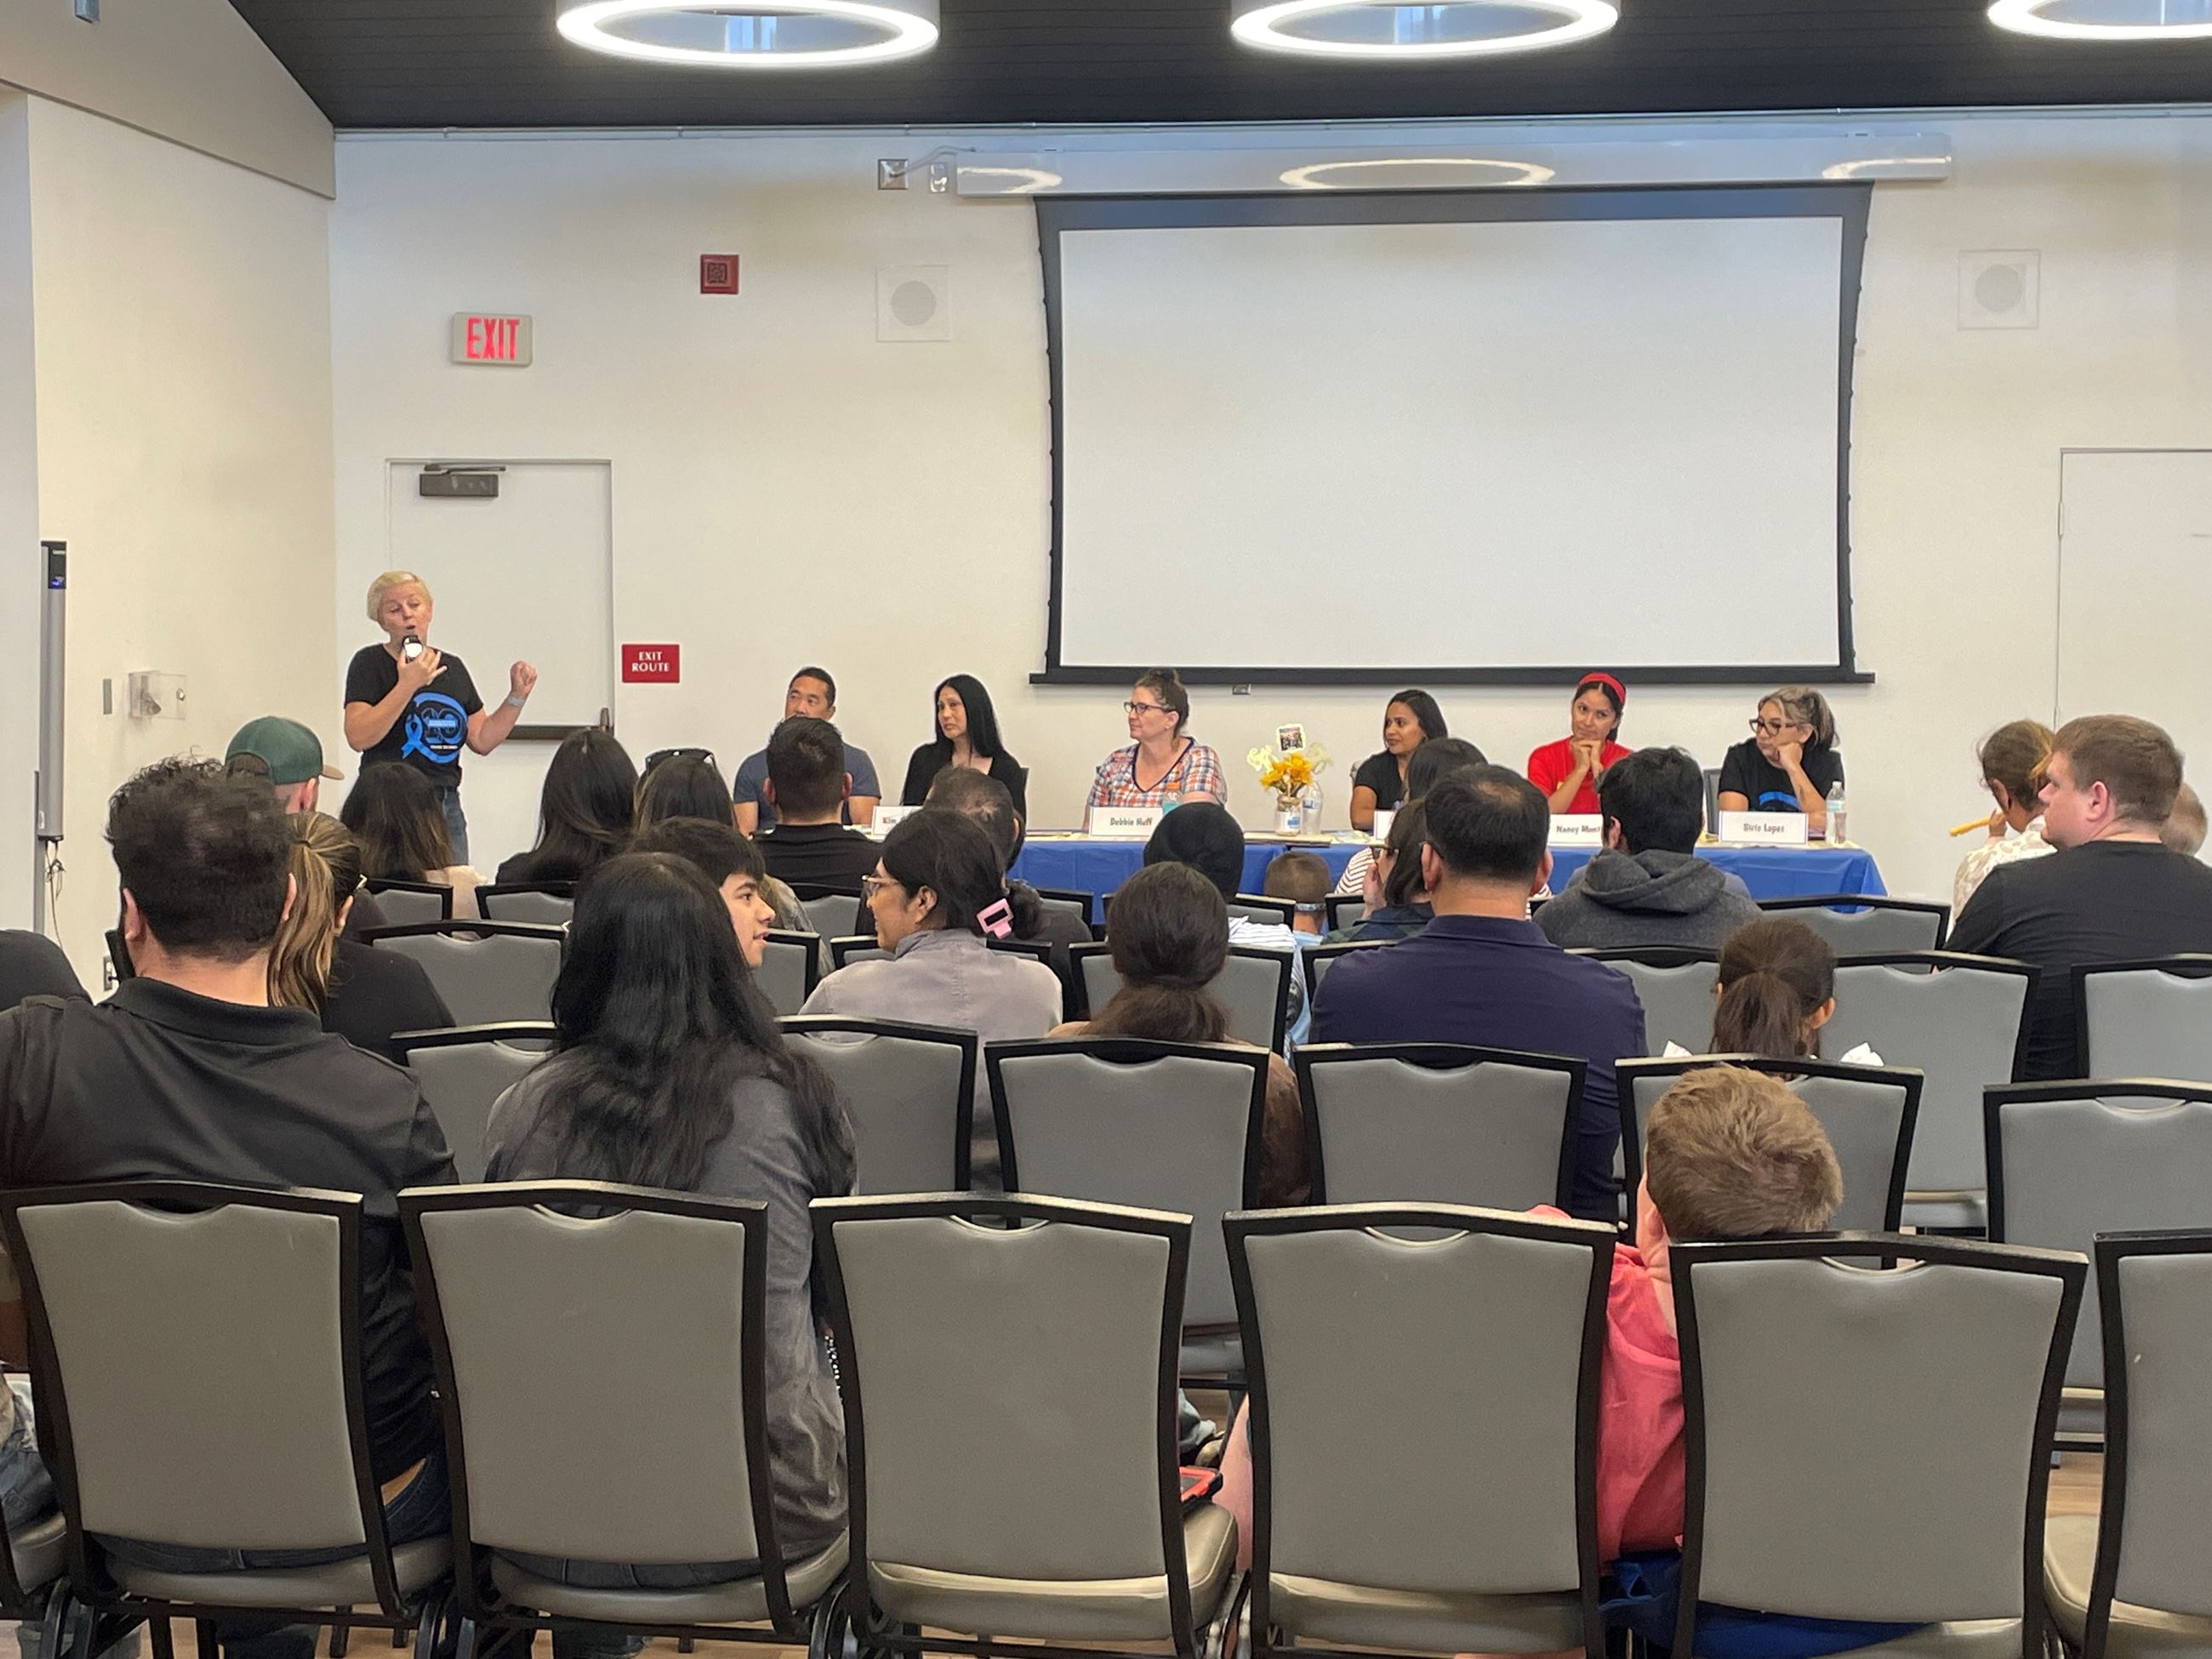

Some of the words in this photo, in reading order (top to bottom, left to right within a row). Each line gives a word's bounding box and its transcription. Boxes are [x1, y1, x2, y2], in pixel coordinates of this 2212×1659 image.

[465, 317, 520, 361] EXIT
[638, 651, 663, 661] EXIT
[631, 662, 670, 673] ROUTE
[1110, 817, 1134, 826] Debbie
